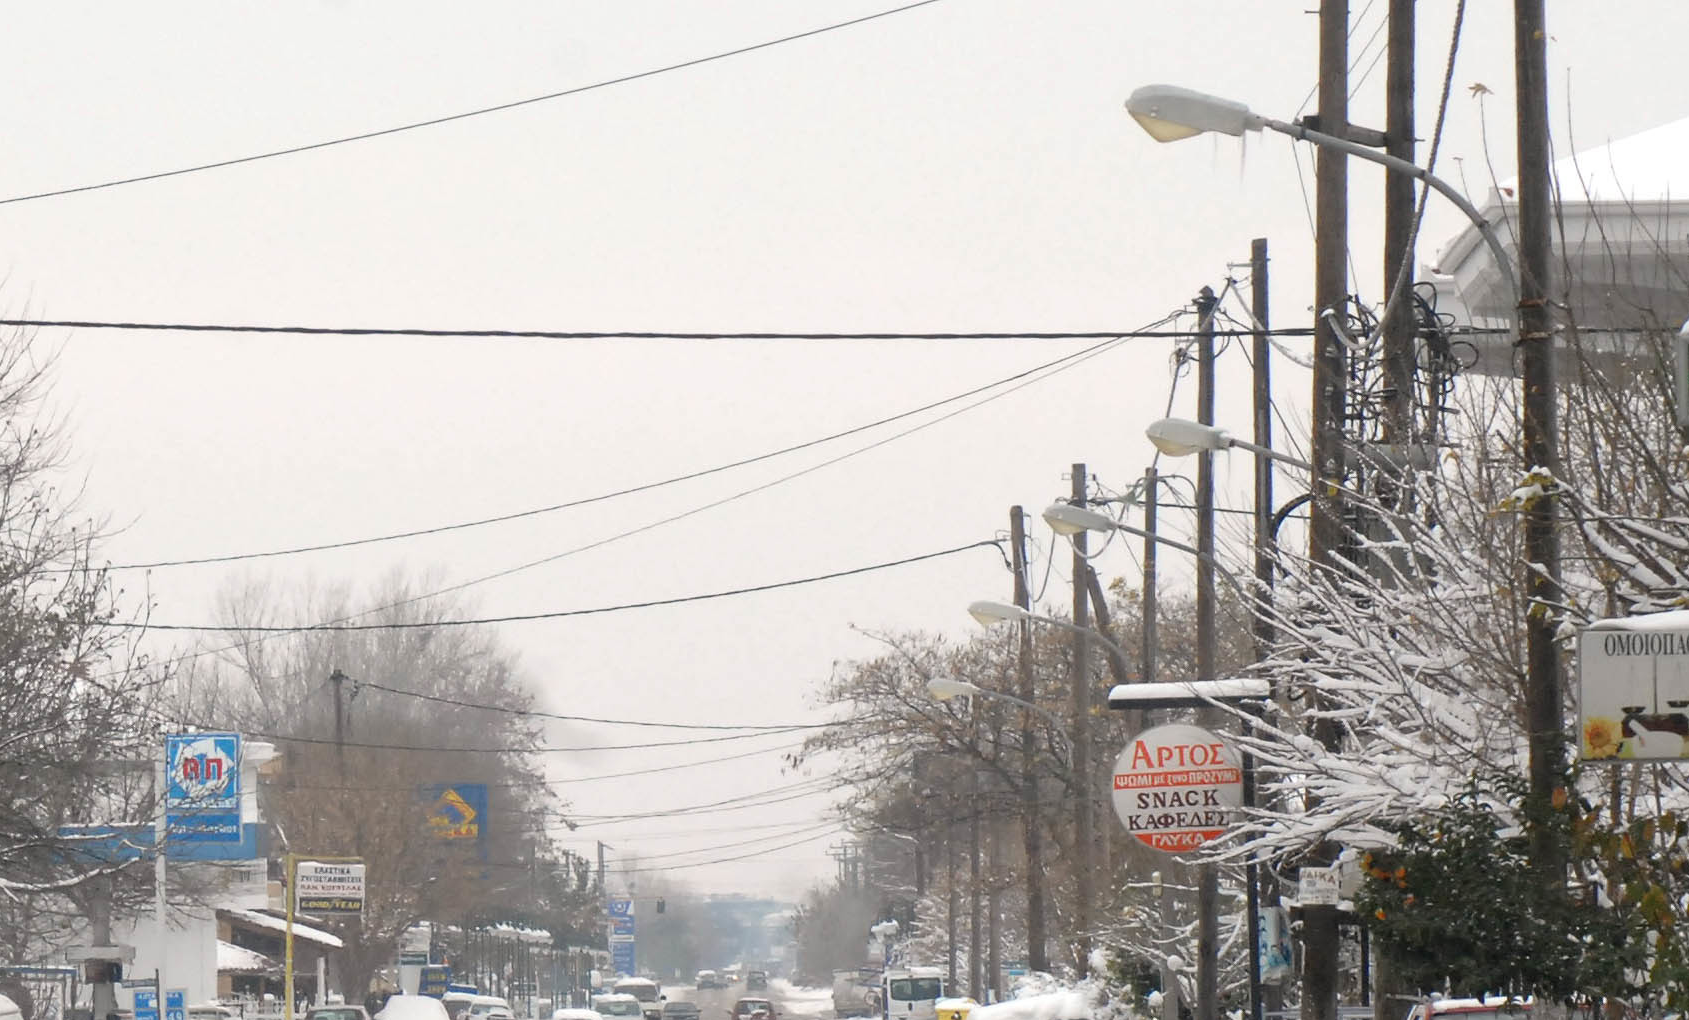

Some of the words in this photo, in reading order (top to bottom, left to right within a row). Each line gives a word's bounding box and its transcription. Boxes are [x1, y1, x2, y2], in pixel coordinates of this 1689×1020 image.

[1603, 632, 1689, 657] ΟΜΟΙΟΠΑ
[1131, 739, 1224, 770] ΑΡΤΟΣ
[1117, 775, 1152, 786] ΨΩΜΙ
[1137, 789, 1220, 809] SNACK
[1127, 810, 1230, 831] ΚΑΦΕΔΕΣ
[1151, 832, 1206, 847] ΓΛΥΚΑ
